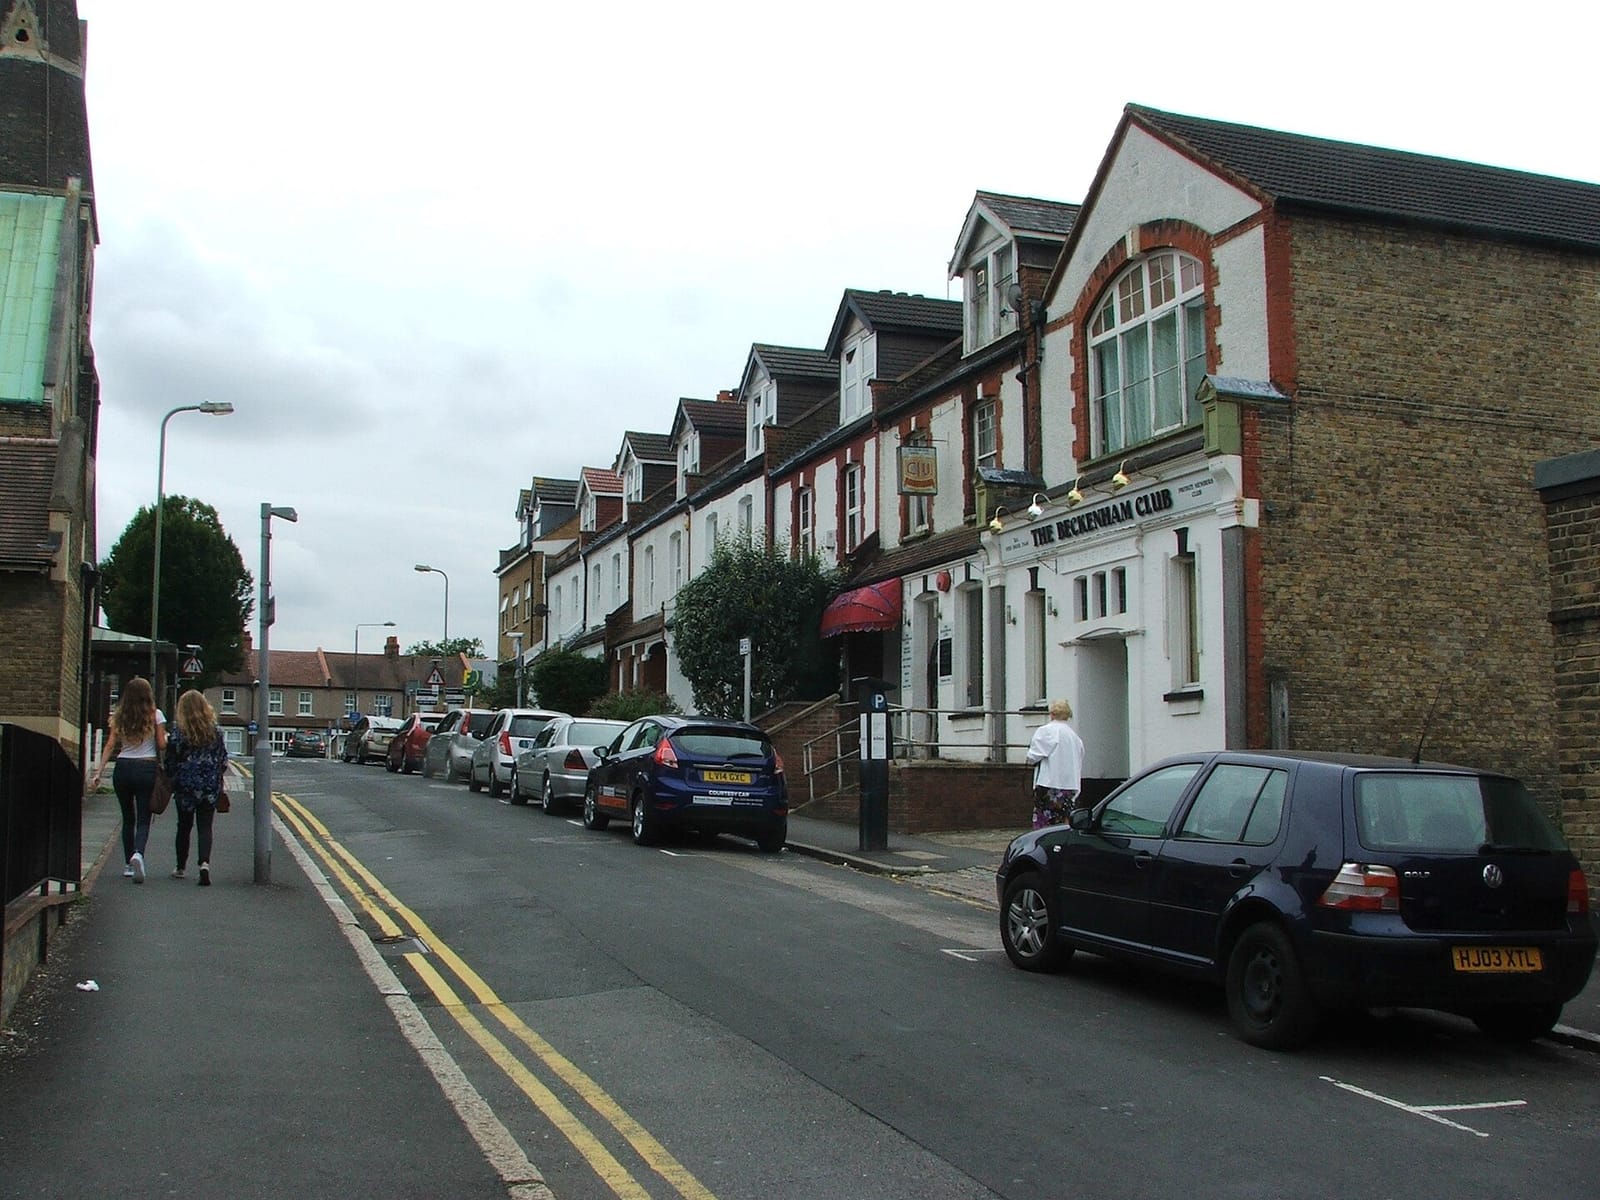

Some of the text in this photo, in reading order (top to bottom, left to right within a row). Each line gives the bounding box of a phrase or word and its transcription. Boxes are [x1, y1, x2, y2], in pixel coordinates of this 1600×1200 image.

[1030, 525, 1054, 547] THE
[1056, 500, 1134, 540] BECKENHAM
[1135, 488, 1174, 517] CLUB
[875, 694, 884, 709] P
[1459, 949, 1536, 968] HJ03 XTL
